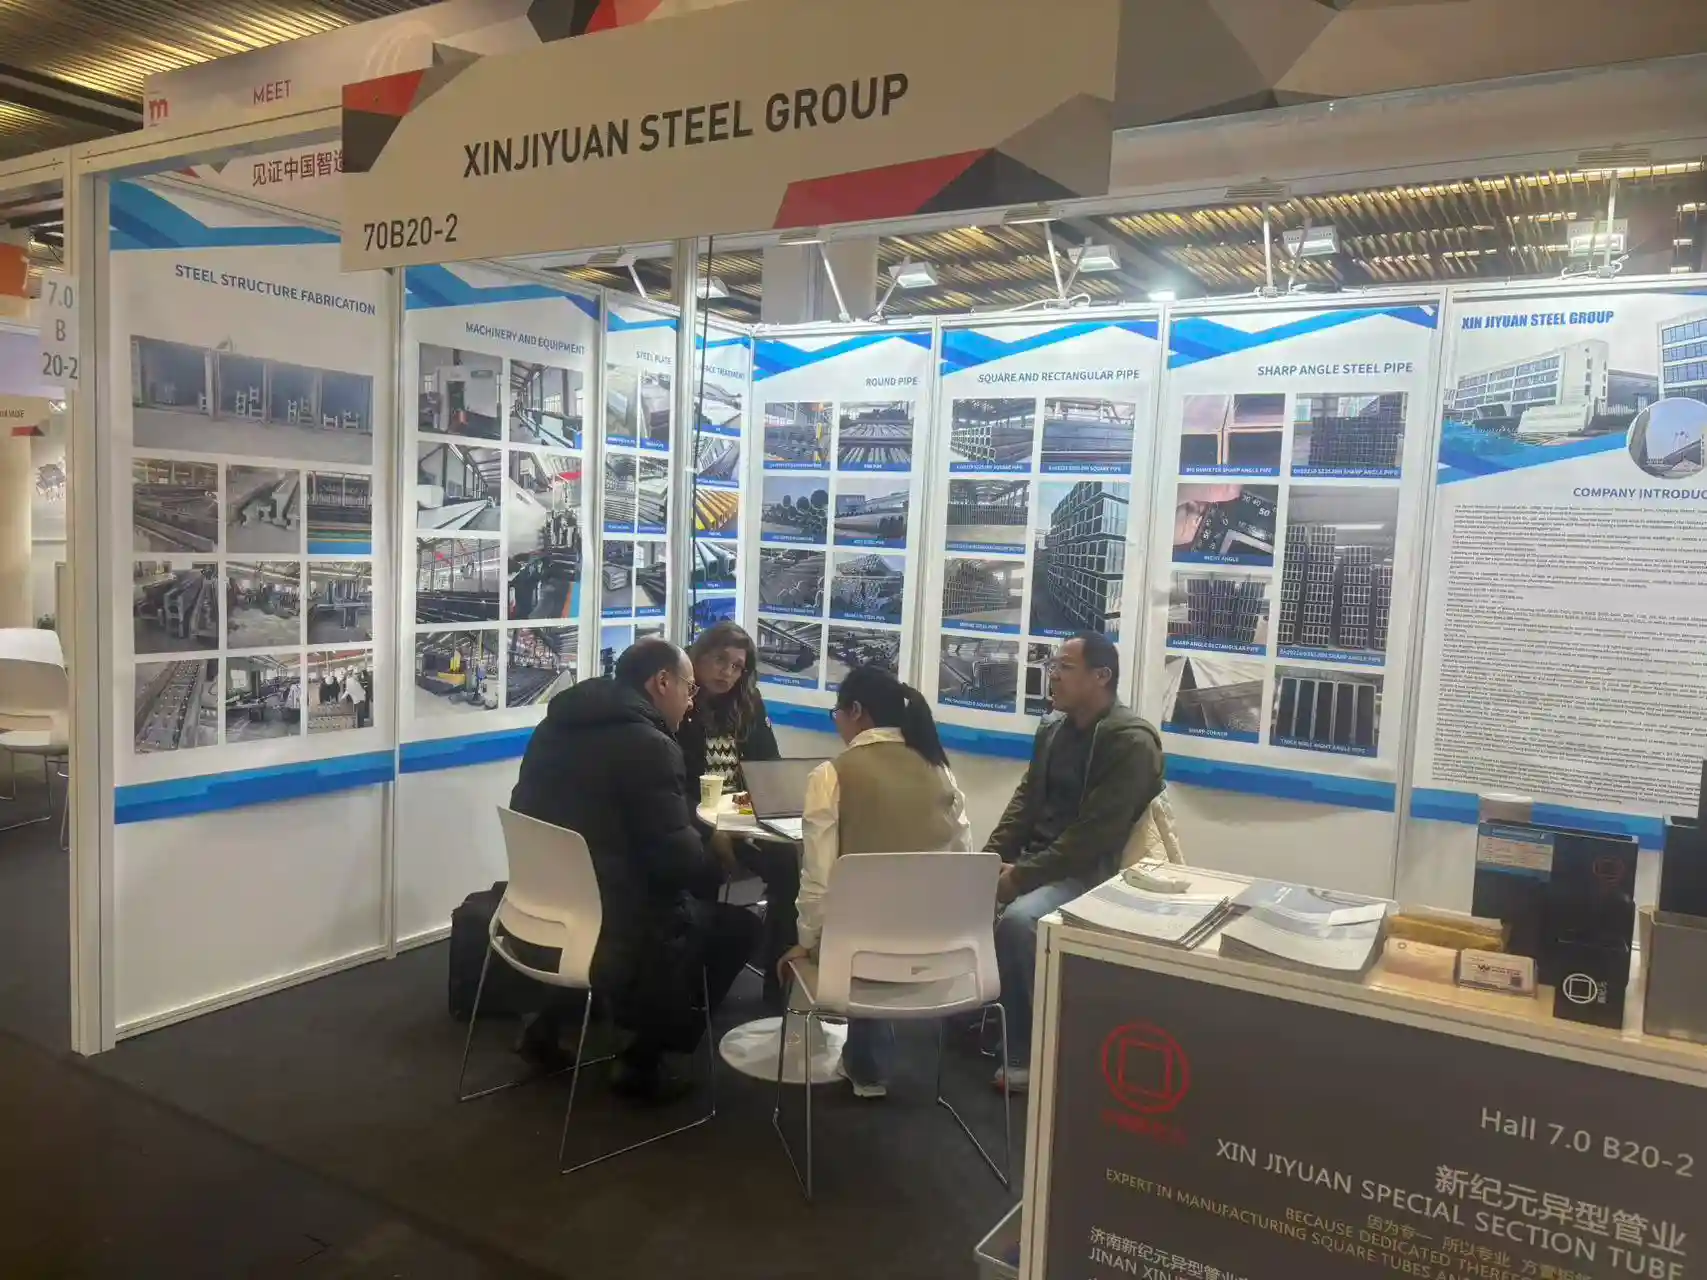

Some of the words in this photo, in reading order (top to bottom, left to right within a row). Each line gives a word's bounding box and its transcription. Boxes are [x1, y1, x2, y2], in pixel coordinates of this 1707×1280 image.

[253, 79, 292, 105] MEET
[462, 118, 628, 178] XINJIYUAN
[639, 100, 753, 152] STEEL
[765, 73, 909, 132] GROUP
[363, 213, 458, 251] 70B20-2
[48, 281, 73, 309] 7.0
[175, 264, 218, 285] STEEL
[221, 273, 297, 300] STRUCTURE
[300, 289, 375, 316] FABRICATION
[55, 319, 66, 341] B
[1461, 316, 1483, 330] XIN
[1484, 313, 1528, 329] JIYUAN
[1530, 312, 1567, 326] STEEL
[1569, 310, 1614, 325] GROUP
[465, 321, 518, 341] MACHINERY
[518, 333, 537, 346] AND
[538, 336, 585, 355] EQUIPMENT
[42, 352, 78, 380] 20-2
[636, 350, 654, 363] STEEL
[654, 353, 672, 365] PLATE
[1257, 365, 1298, 376] SHARP
[1299, 364, 1340, 375] ANGLE
[1342, 363, 1381, 374] STEEL
[1384, 362, 1413, 373] PIPE
[865, 377, 896, 387] ROUND
[898, 376, 918, 386] PIPE
[978, 373, 1017, 384] SQUARE
[1018, 372, 1039, 382] AND
[1041, 369, 1114, 383] RECTANGULAR
[1116, 369, 1140, 380] PIPE
[1573, 487, 1636, 499] COMPANY
[1638, 487, 1707, 500] INTRODUC
[1480, 1107, 1537, 1141] Hall
[1547, 1122, 1592, 1153] 7.0
[1602, 1136, 1695, 1178] B20-2
[1215, 1138, 1257, 1166] XIN
[1264, 1153, 1352, 1195] JIYUAN
[1361, 1180, 1466, 1227] SPECIAL
[1474, 1211, 1597, 1262] SECTION
[1434, 1164, 1688, 1257] 新纪元异型管业
[1105, 1167, 1154, 1194] EXPERT
[1156, 1183, 1173, 1199] IN
[1177, 1189, 1307, 1241] MANUFACTURING
[1311, 1231, 1378, 1262] SQUARE
[1381, 1252, 1431, 1279] TUBES
[1285, 1206, 1354, 1238] BECAUSE
[1359, 1229, 1451, 1267] DEDICATED
[1088, 1247, 1137, 1275] JINAN
